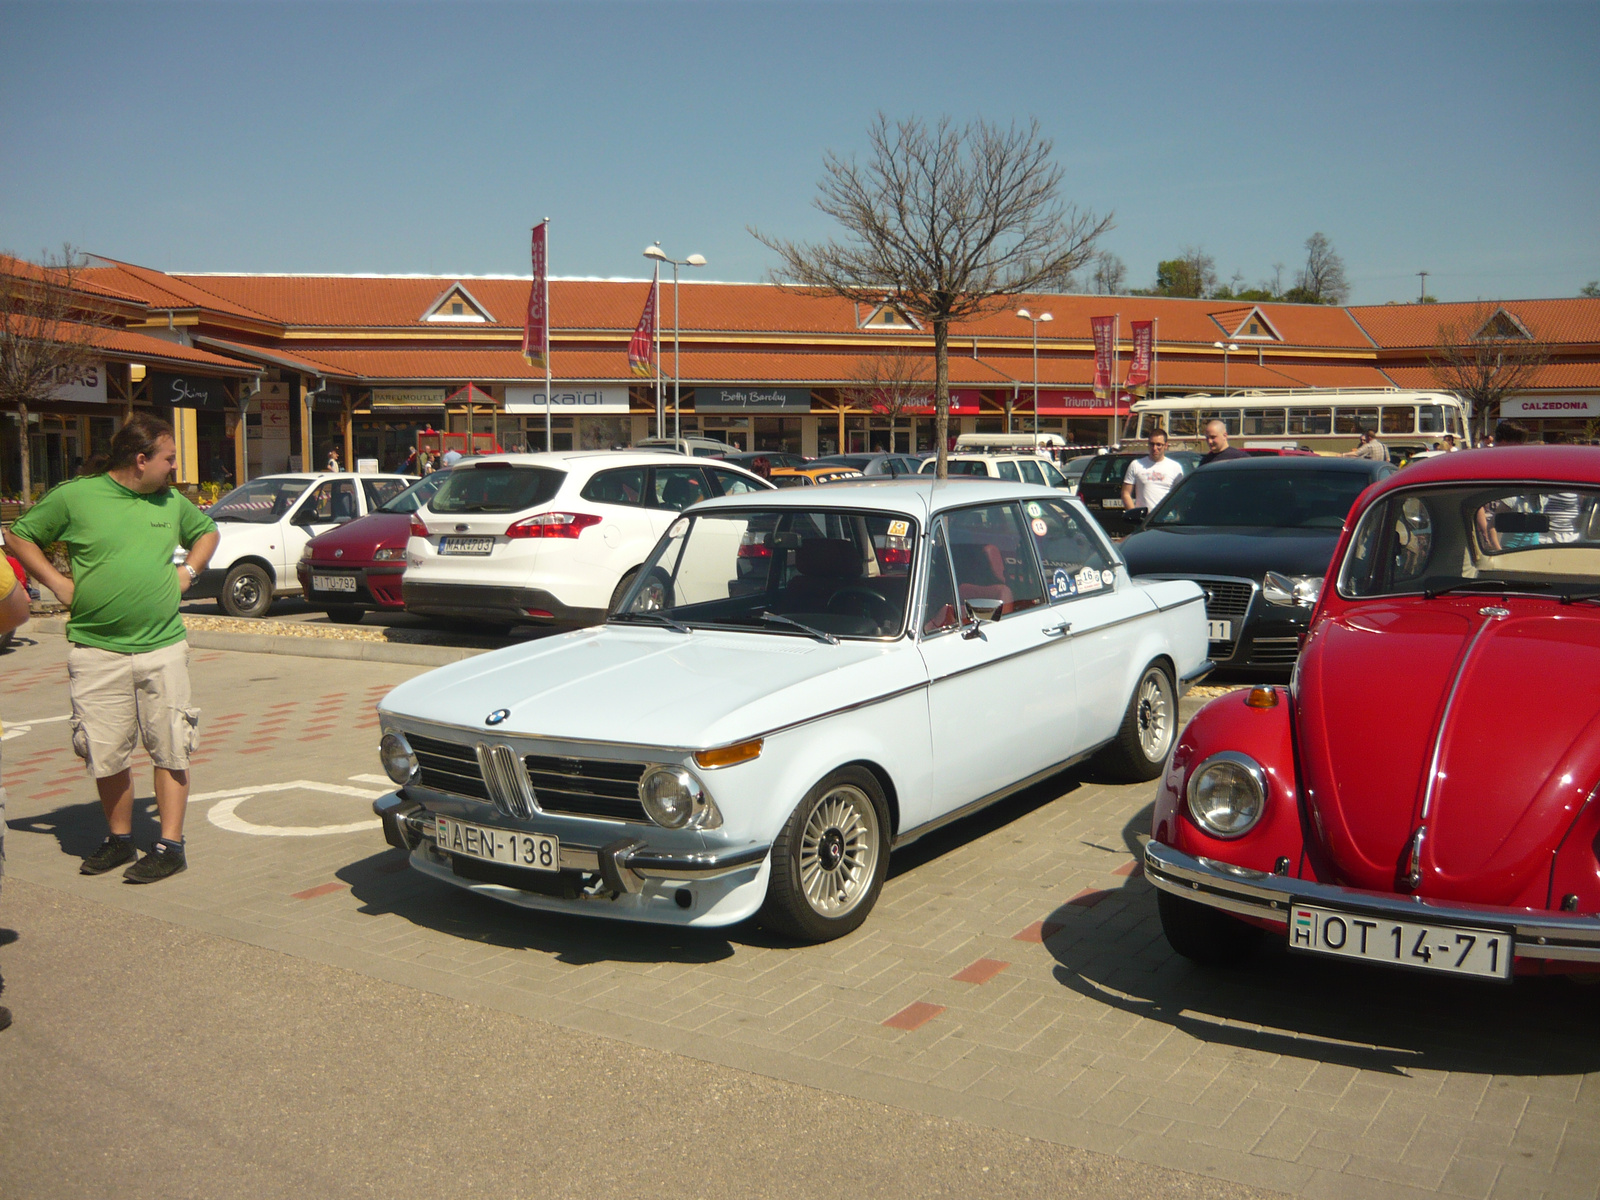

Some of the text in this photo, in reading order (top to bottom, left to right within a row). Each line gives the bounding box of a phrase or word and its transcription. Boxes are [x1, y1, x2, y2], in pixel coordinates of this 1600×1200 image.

[533, 391, 603, 405] okaïdi
[721, 390, 786, 408] Betty Barclay
[1063, 396, 1102, 409] Triumph
[1521, 402, 1588, 410] CALZEDONIA
[1208, 621, 1225, 638] 11
[453, 822, 553, 867] AEN-138
[1322, 915, 1377, 955] OT
[1391, 924, 1500, 973] 14-71
